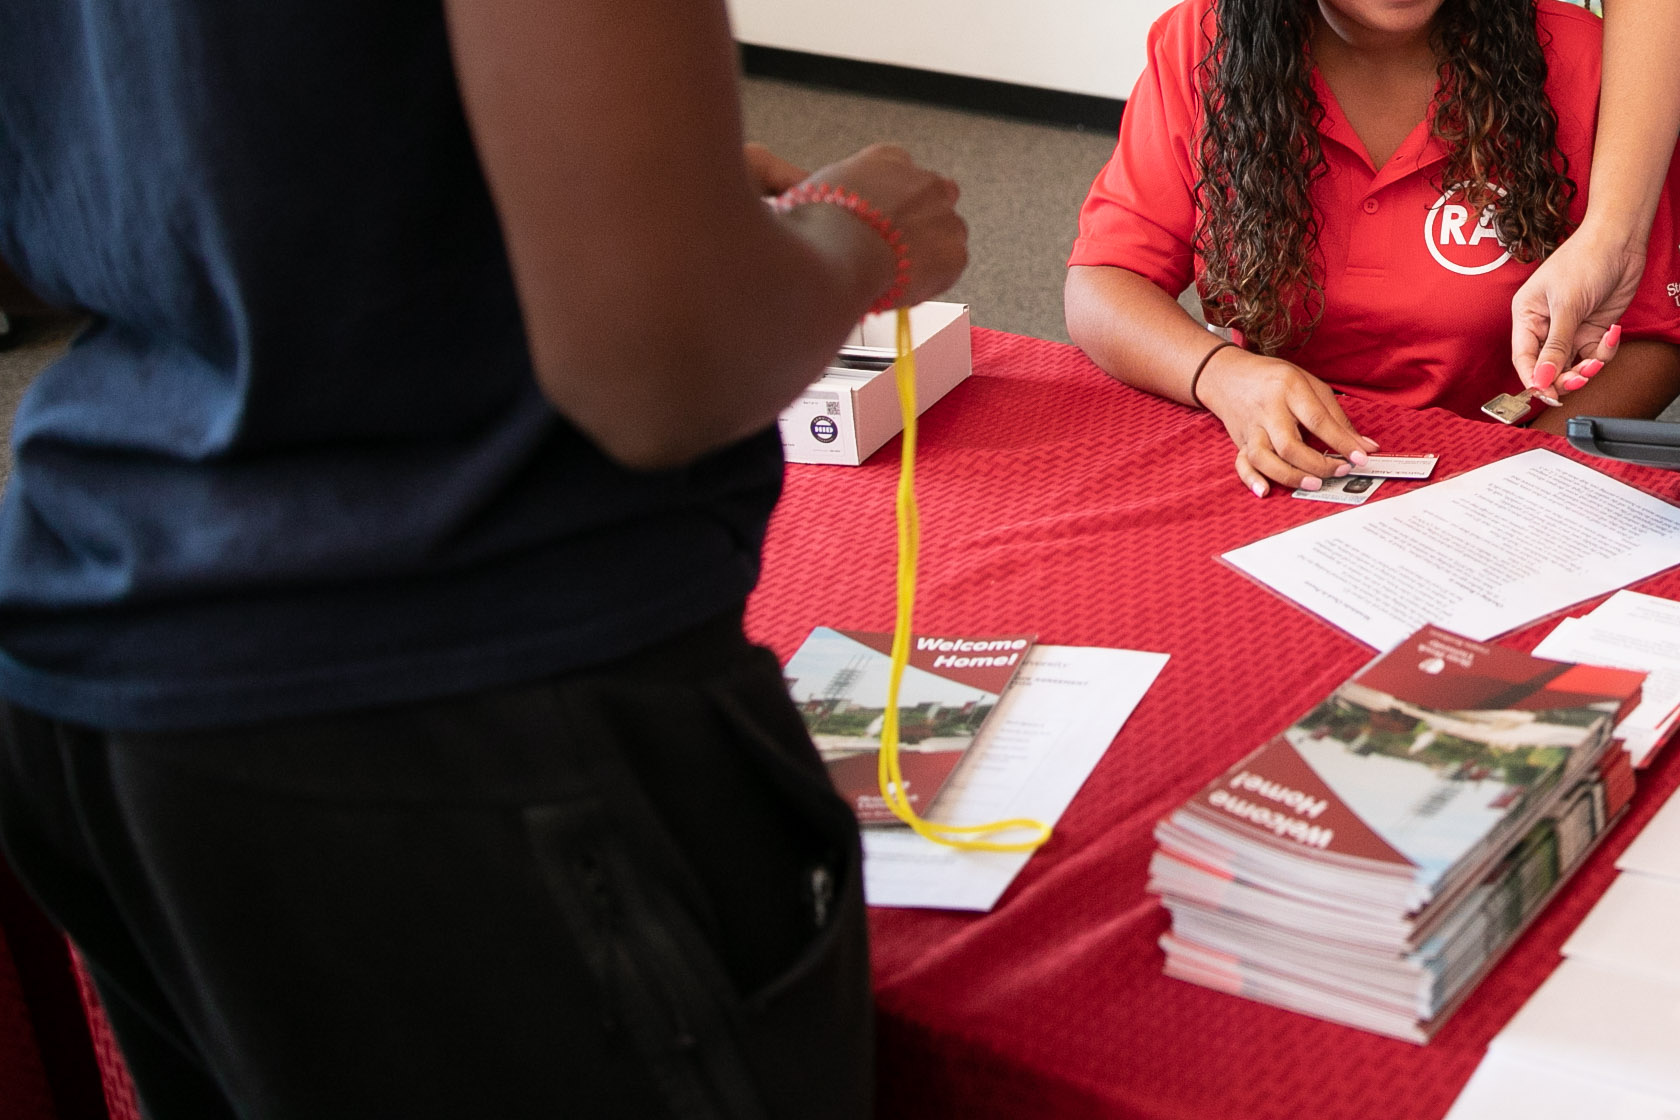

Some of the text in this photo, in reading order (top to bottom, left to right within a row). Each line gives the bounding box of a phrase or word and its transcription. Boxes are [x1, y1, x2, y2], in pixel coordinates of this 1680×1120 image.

[916, 636, 1027, 653] Welcome
[933, 653, 1019, 670] Home!
[1232, 771, 1328, 820] Home!
[1208, 789, 1334, 849] Welcome
